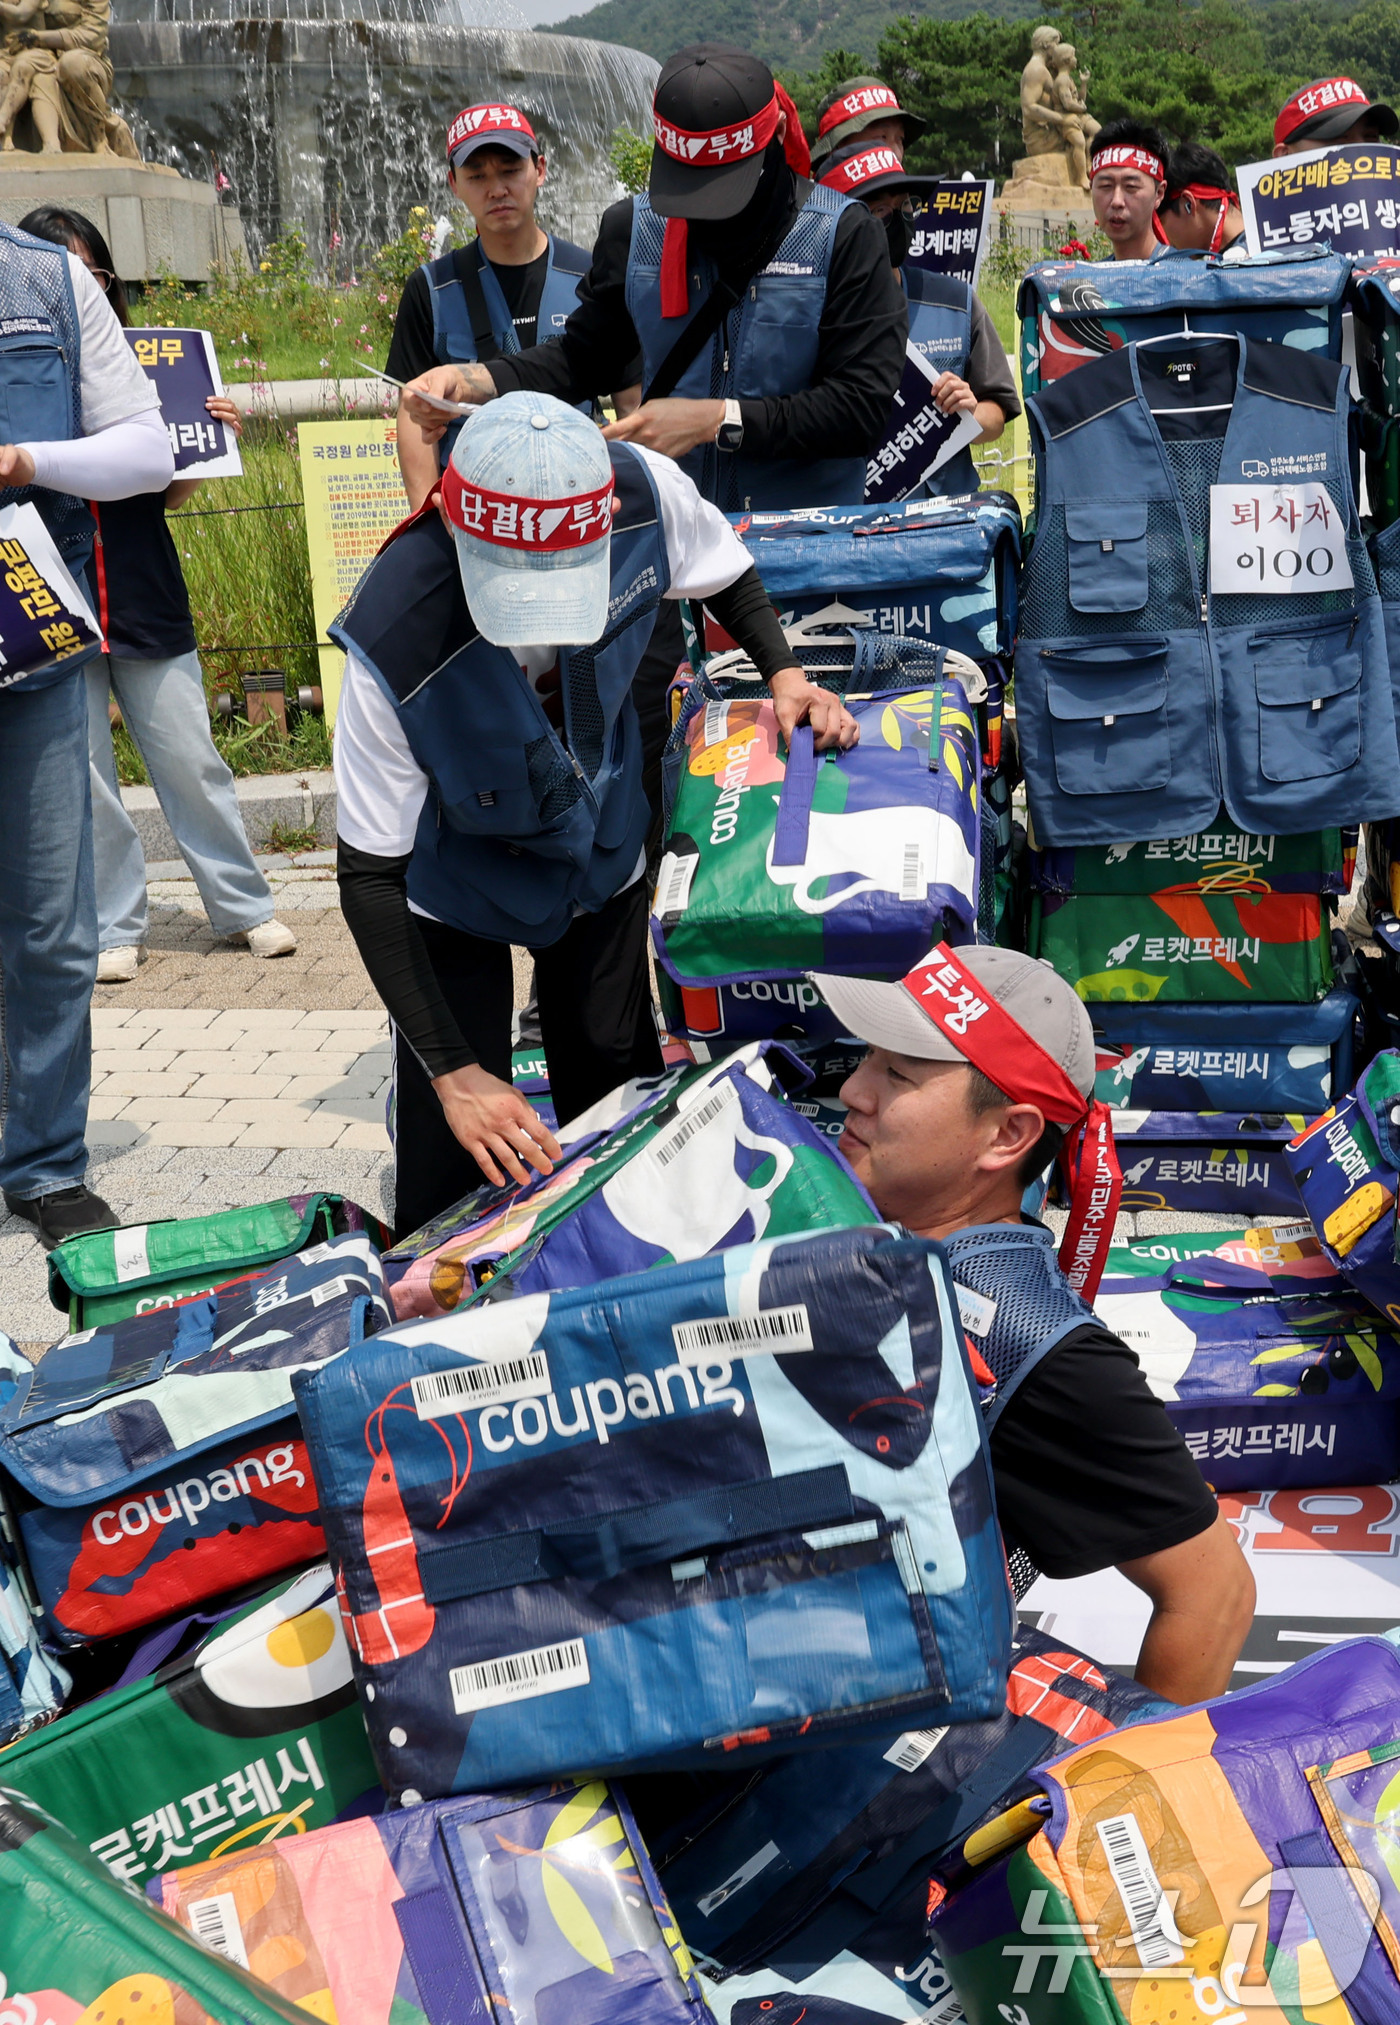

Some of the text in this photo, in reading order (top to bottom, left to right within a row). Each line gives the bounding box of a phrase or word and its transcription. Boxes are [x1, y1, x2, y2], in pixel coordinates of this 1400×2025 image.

[843, 88, 876, 114] 단결
[1298, 83, 1337, 115] 단결
[488, 107, 521, 127] 투쟁
[708, 125, 754, 160] 투쟁
[843, 151, 882, 182] 단결
[1092, 147, 1159, 175] 단결 투쟁
[1258, 155, 1392, 199] 야간배송으로
[933, 190, 982, 215] 무너진
[1262, 200, 1371, 248] 노동자의
[1375, 199, 1400, 229] 생
[134, 338, 184, 366] 업무
[313, 443, 398, 460] 국정원 살인청
[1271, 461, 1327, 477] 전국택배노동조합
[461, 488, 613, 540] 단결 투쟁
[709, 737, 760, 845] coupang
[1145, 834, 1275, 862] 로켓프레시
[1142, 936, 1260, 964] 로켓프레시
[731, 980, 827, 1013] coup
[921, 963, 990, 1035] 투쟁
[1151, 1050, 1270, 1080] 로켓프레시
[1325, 1119, 1371, 1195] coupang
[1155, 1159, 1270, 1189] 로켓프레시
[960, 1309, 981, 1329] 상현
[479, 1359, 745, 1453] coupang
[1184, 1422, 1337, 1460] 로켓프레시
[92, 1444, 305, 1545] coupang
[89, 1736, 325, 1879] 로켓프레시
